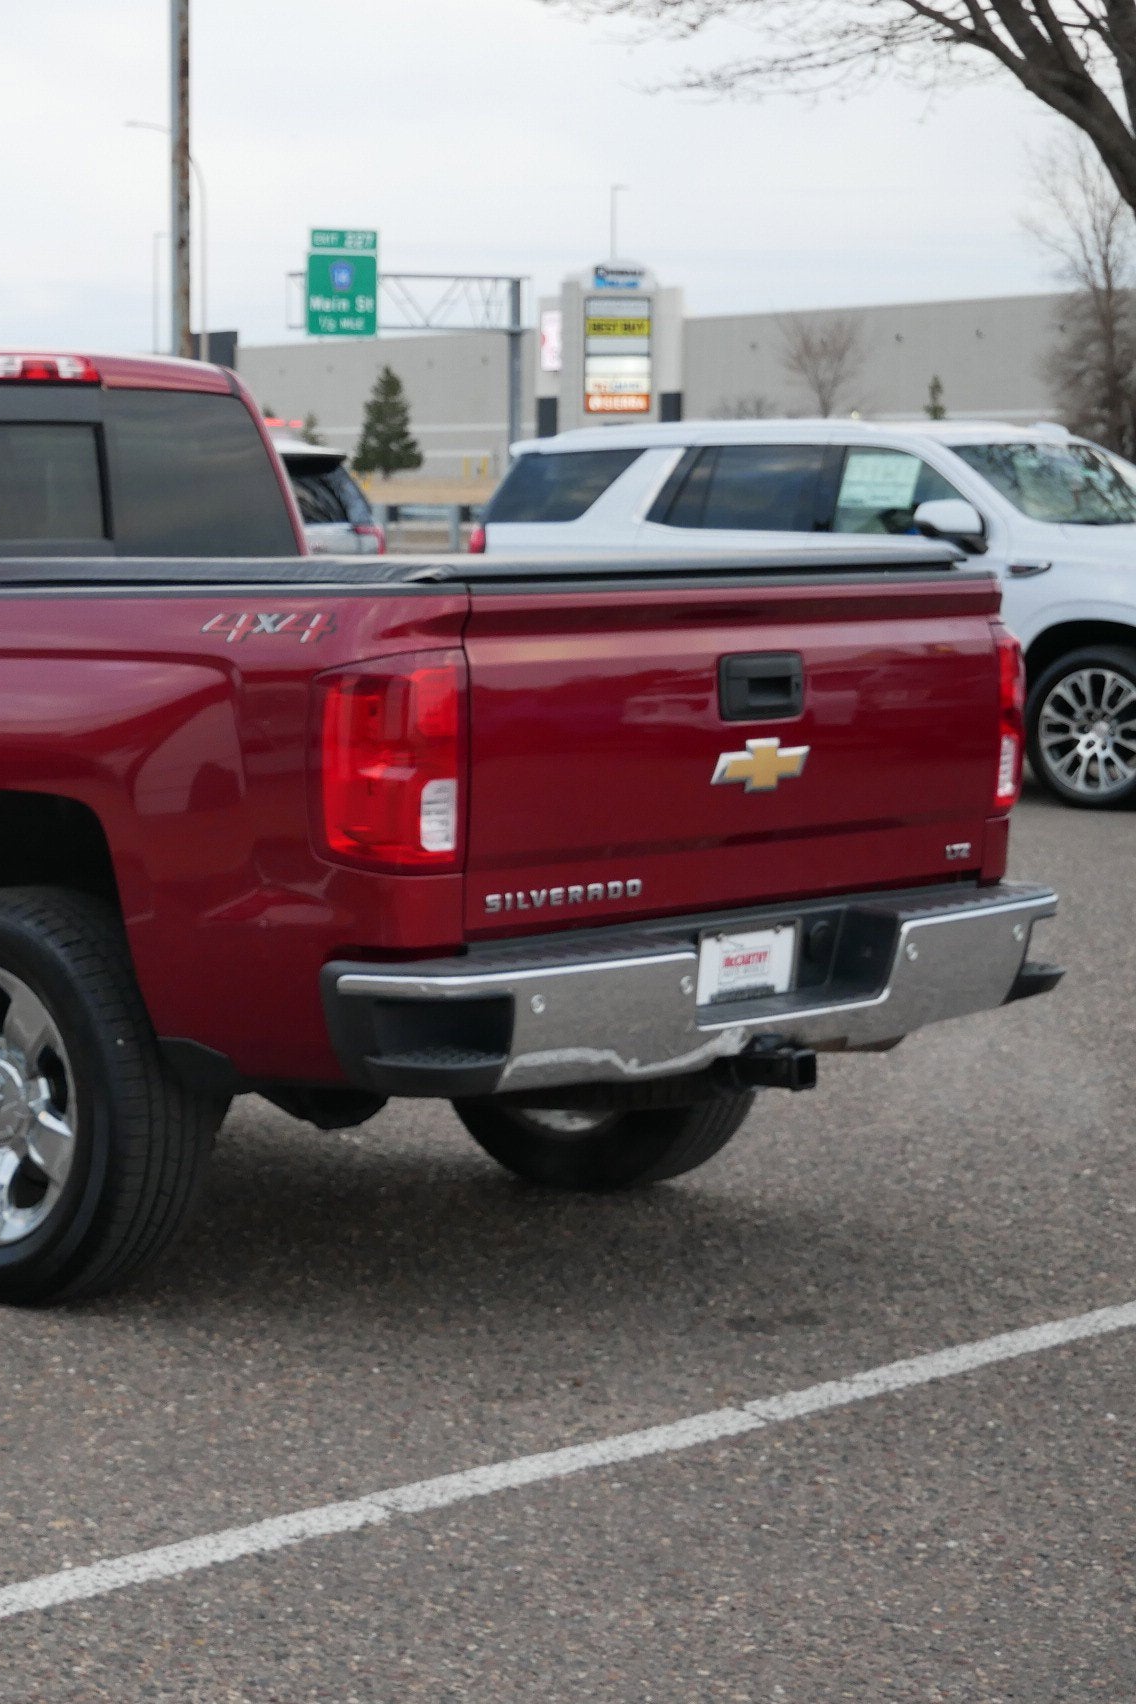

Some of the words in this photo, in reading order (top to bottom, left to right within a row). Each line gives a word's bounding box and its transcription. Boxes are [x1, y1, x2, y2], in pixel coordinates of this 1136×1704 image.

[310, 295, 350, 313] Main
[355, 295, 375, 313] St
[485, 878, 643, 914] SILVERADO
